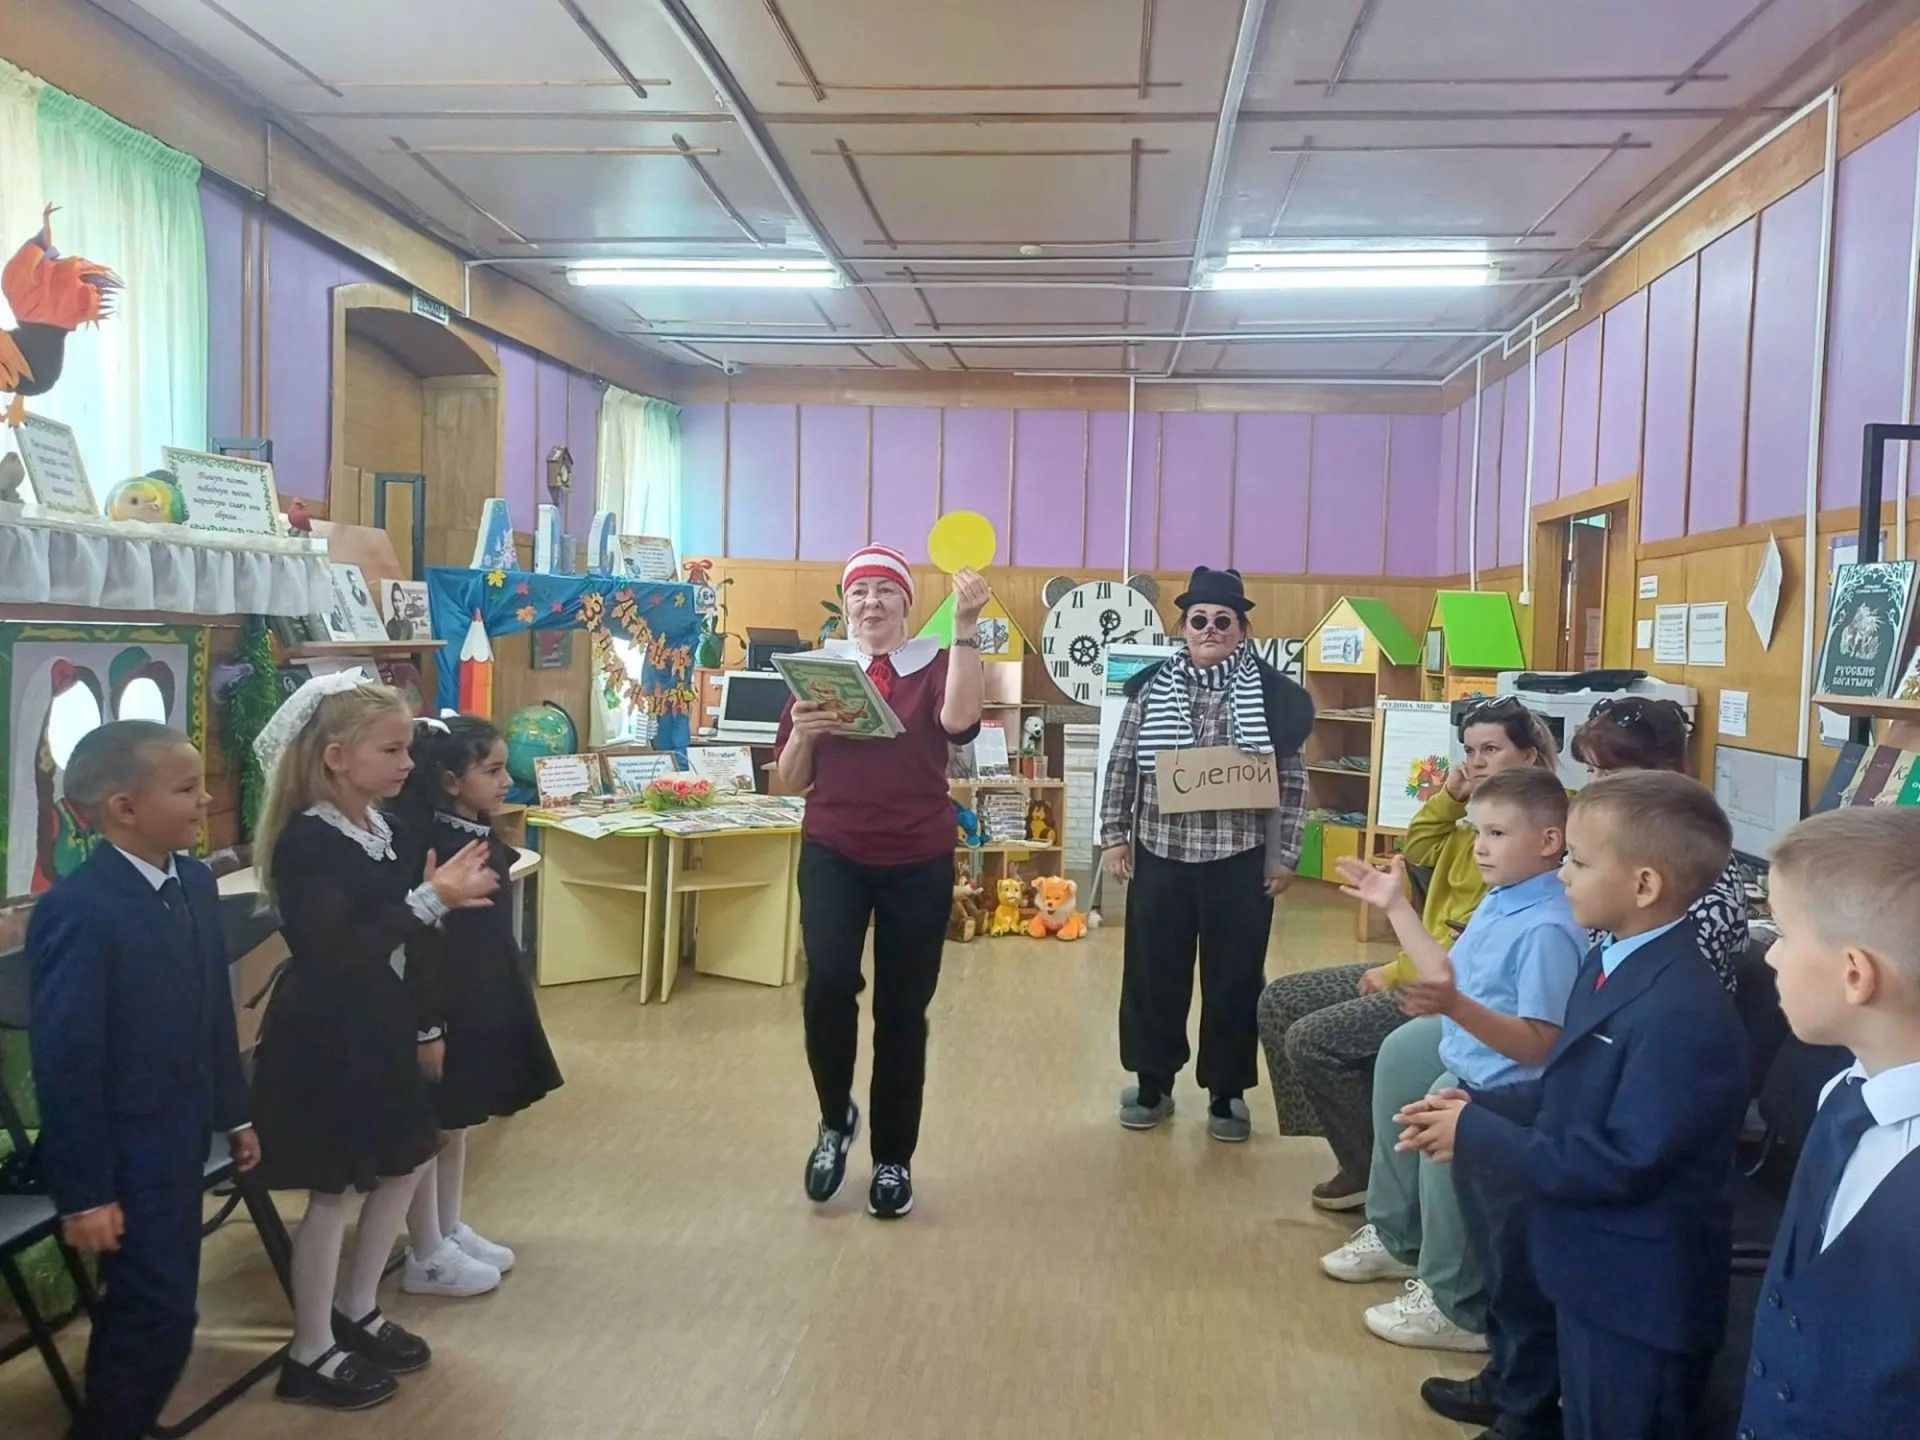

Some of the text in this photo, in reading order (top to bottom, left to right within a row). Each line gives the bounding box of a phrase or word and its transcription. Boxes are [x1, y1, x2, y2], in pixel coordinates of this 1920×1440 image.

[703, 591, 714, 600] 6+
[1096, 582, 1111, 599] XII
[1072, 591, 1083, 608] XI
[616, 594, 686, 667] ДЕНЬ
[1050, 661, 1069, 677] VIII
[1834, 665, 1876, 677] РУССКИЕ
[1832, 677, 1874, 688] БОГАТЫРИ
[1072, 683, 1089, 699] VII
[1172, 761, 1272, 794] Слепой
